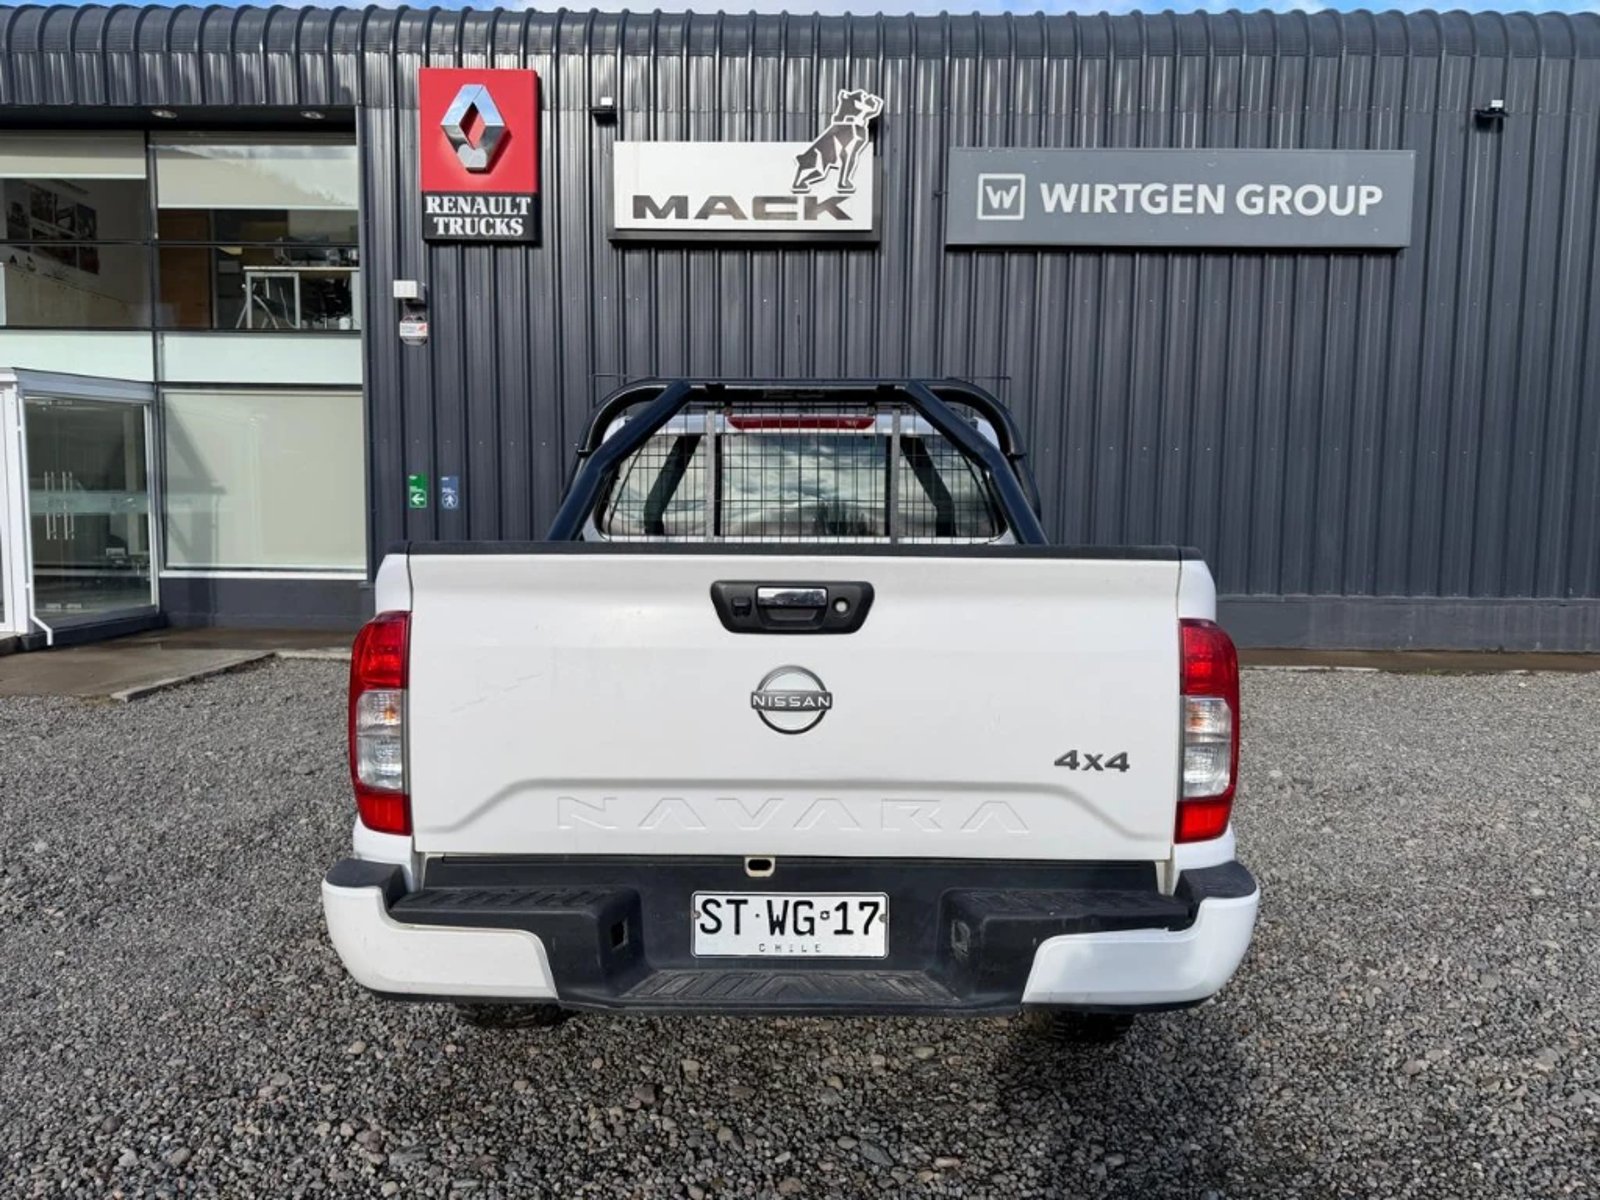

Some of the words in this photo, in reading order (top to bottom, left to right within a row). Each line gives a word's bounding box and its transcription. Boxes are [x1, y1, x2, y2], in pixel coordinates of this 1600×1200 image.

[425, 196, 531, 215] RENAULT
[632, 194, 853, 221] MACK
[1040, 182, 1225, 215] WIRTGEN
[1235, 184, 1384, 217] GROUP
[433, 216, 524, 236] TRUCKS
[752, 694, 831, 707] NISSAN
[1053, 749, 1131, 773] 4x4
[556, 796, 1031, 834] NAVARA
[758, 943, 822, 953] CHILE
